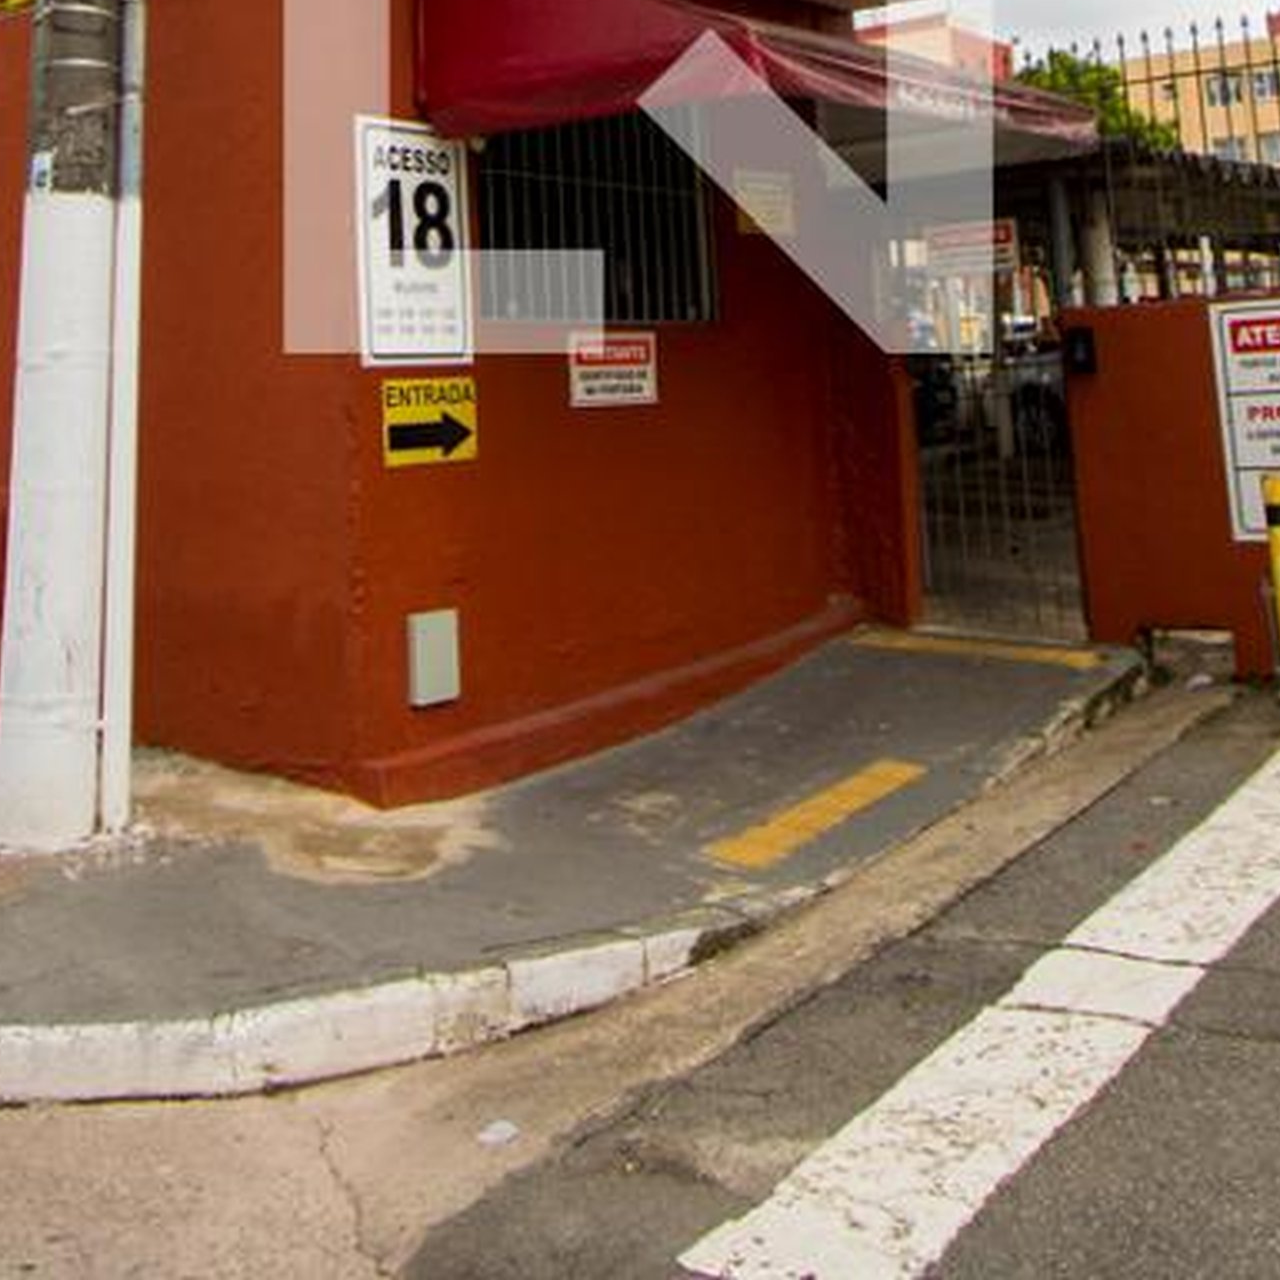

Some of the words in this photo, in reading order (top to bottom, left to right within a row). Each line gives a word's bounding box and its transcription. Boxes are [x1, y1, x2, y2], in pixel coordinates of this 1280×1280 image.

[373, 144, 451, 176] ACESSO
[372, 179, 454, 270] 18
[386, 382, 474, 409] ENTRADA
